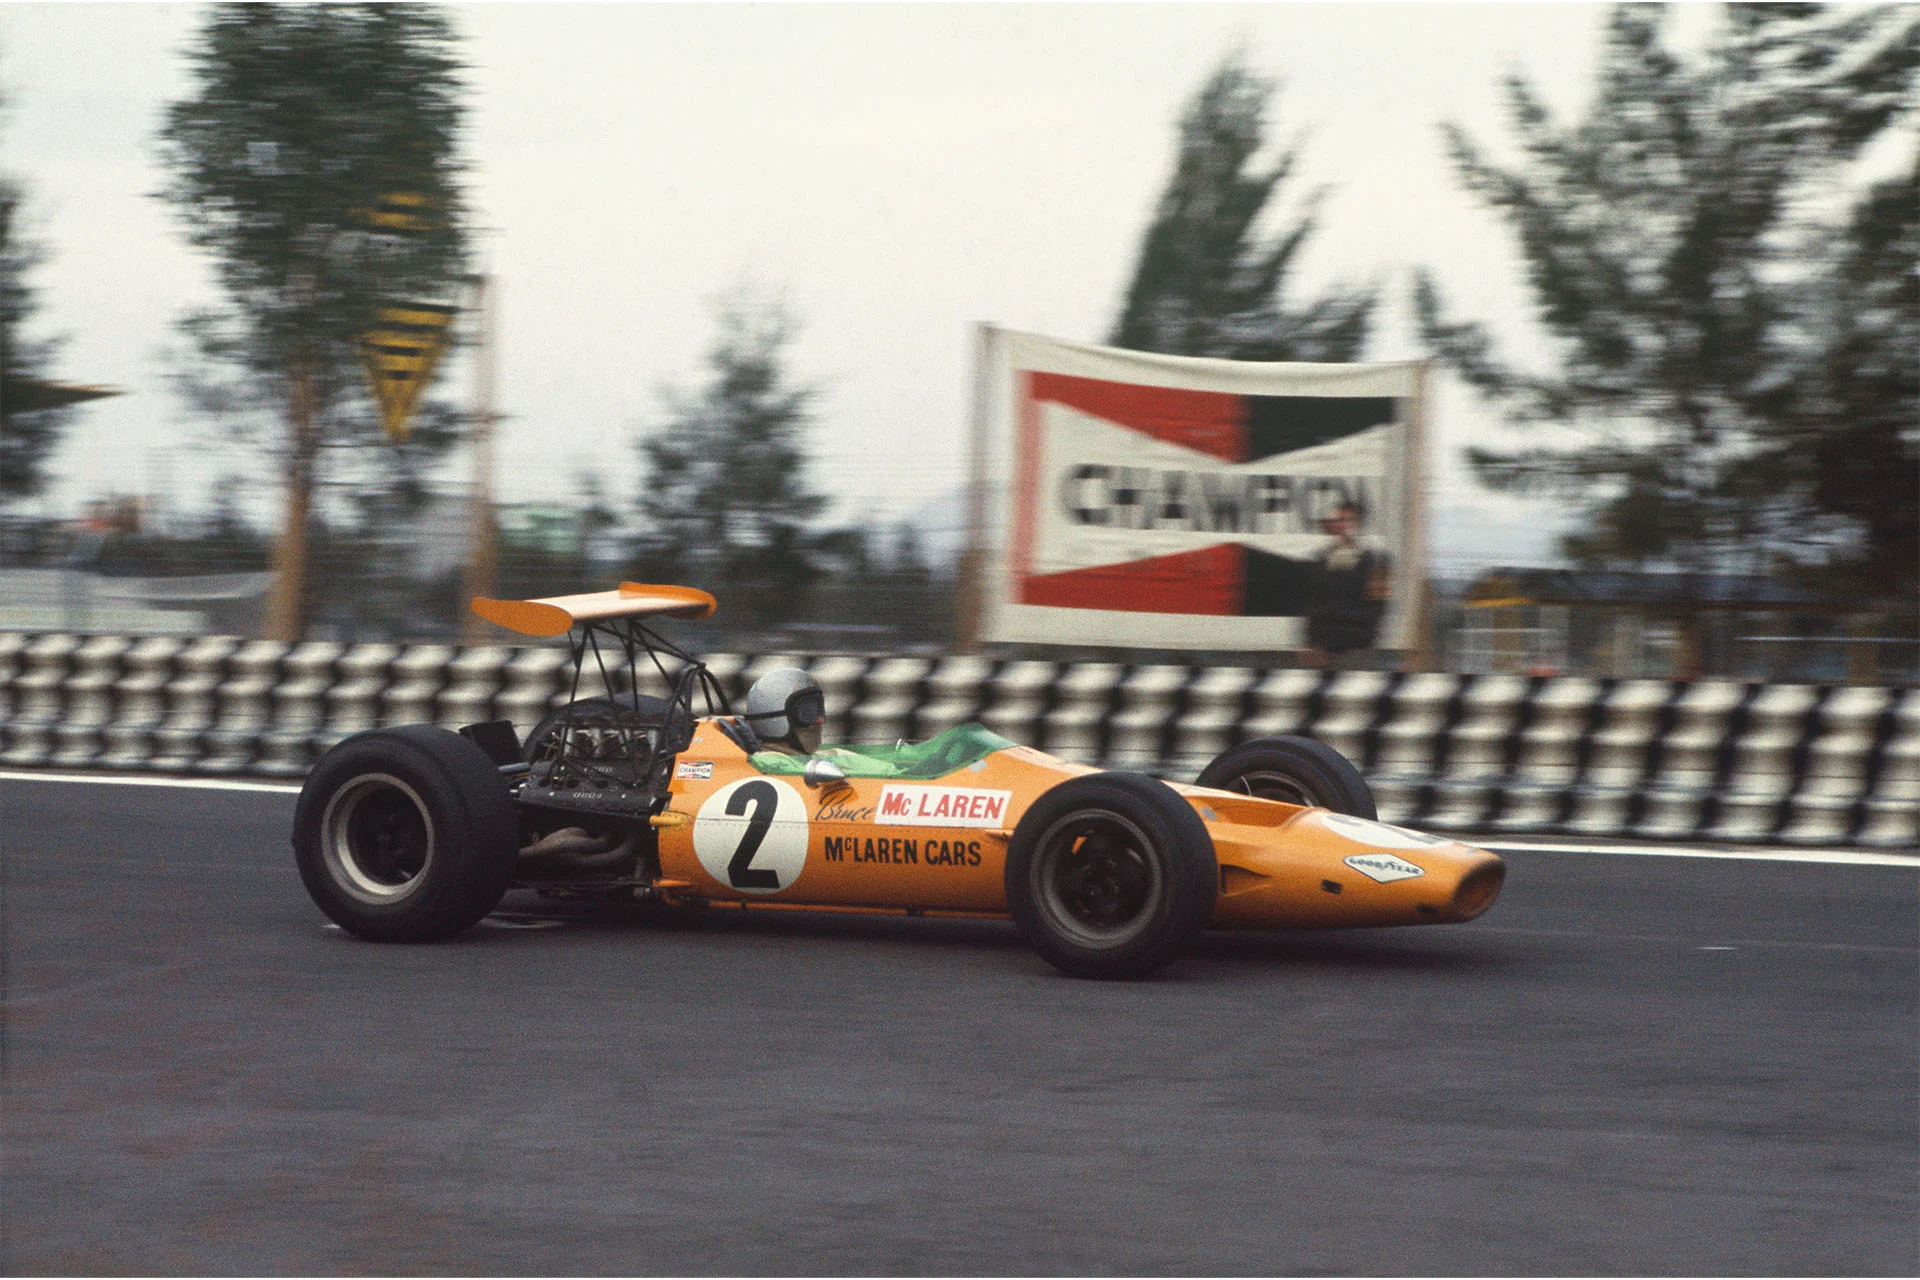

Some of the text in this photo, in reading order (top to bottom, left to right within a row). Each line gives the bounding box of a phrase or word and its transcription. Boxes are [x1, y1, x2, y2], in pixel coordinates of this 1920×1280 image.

[679, 766, 711, 774] CHAMPION
[815, 789, 876, 822] Bruce
[917, 796, 1004, 820] LAREN
[724, 780, 780, 889] 2
[925, 840, 981, 867] CARS
